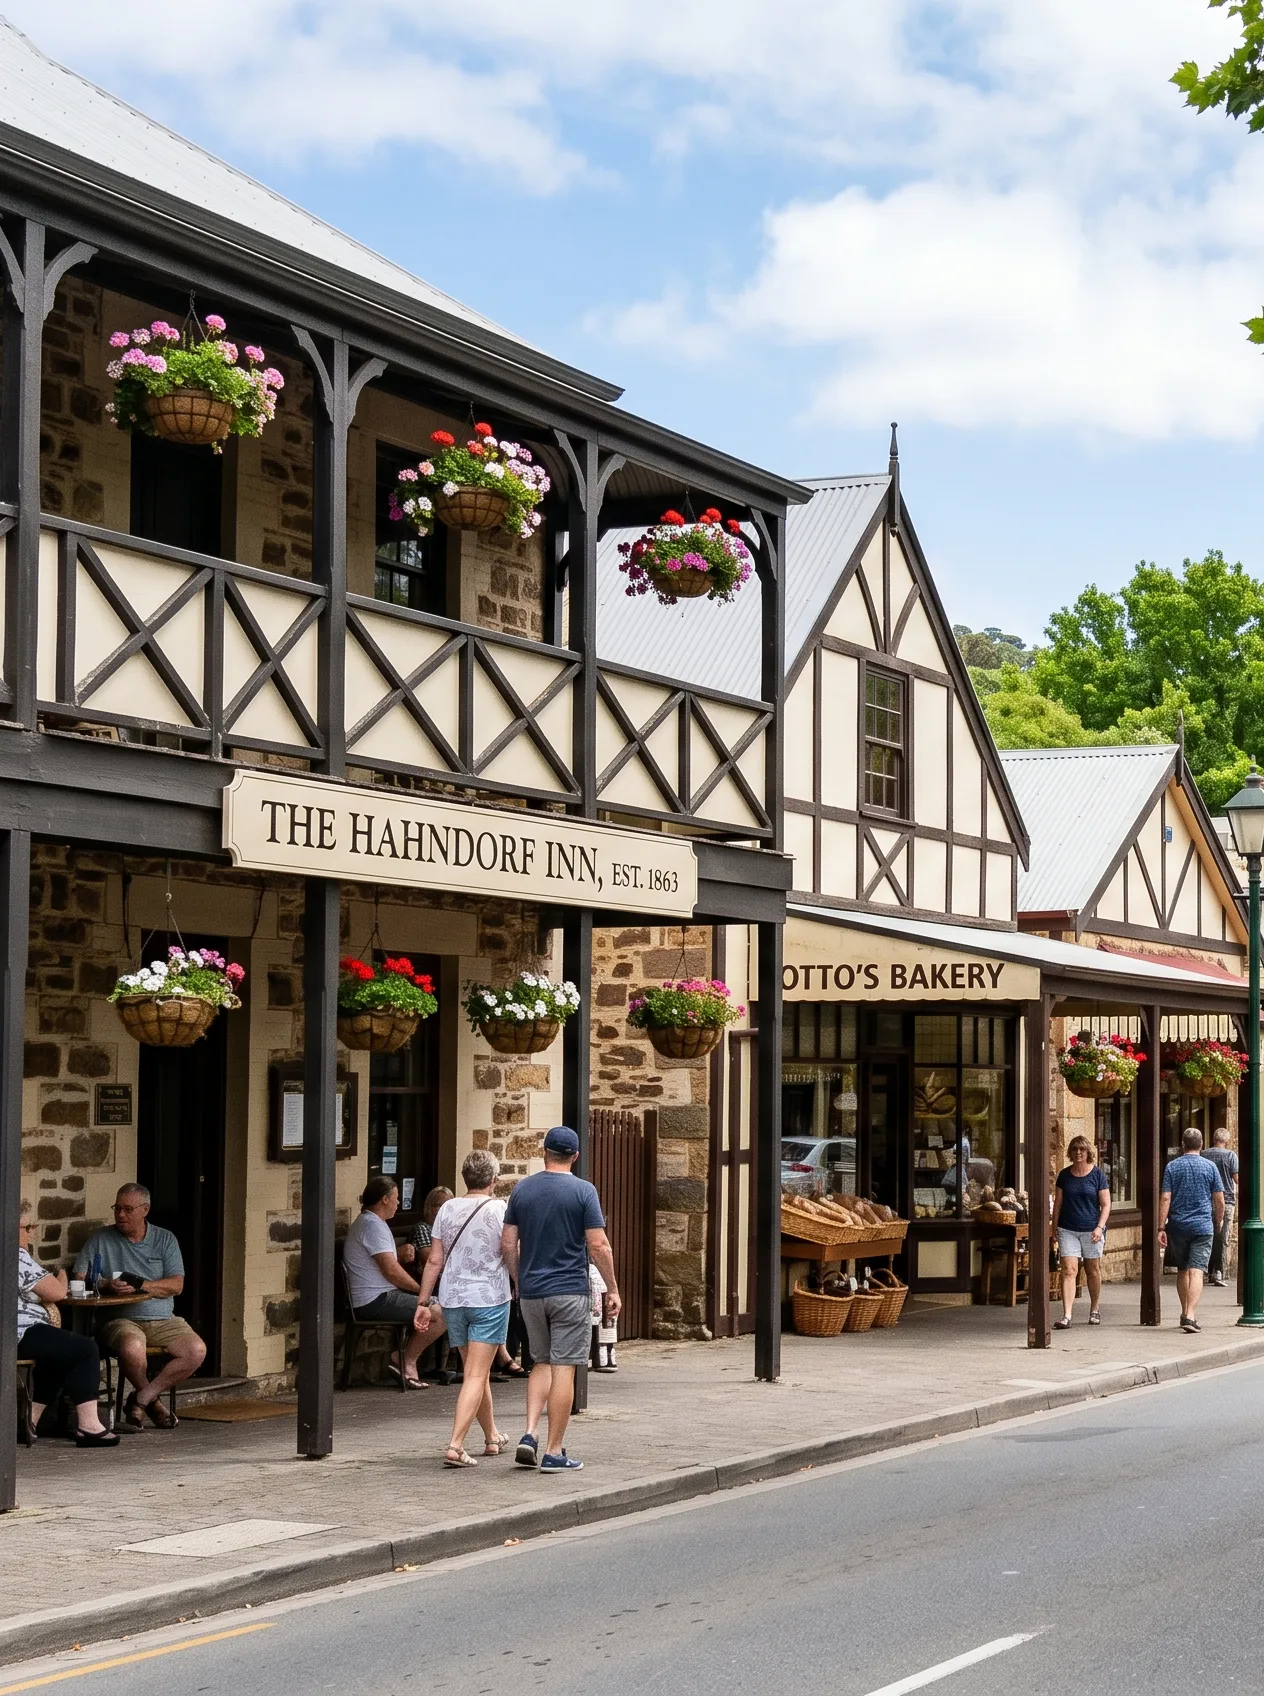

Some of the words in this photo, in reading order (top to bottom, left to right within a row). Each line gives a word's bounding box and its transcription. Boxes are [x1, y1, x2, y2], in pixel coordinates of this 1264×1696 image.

[261, 800, 337, 851] THE
[348, 811, 535, 875] HAHNDORF
[545, 840, 604, 893] INN,
[611, 862, 644, 890] EST.
[648, 870, 680, 893] 1863
[782, 963, 880, 991] OTTO'S
[890, 963, 1005, 989] BAKERY
